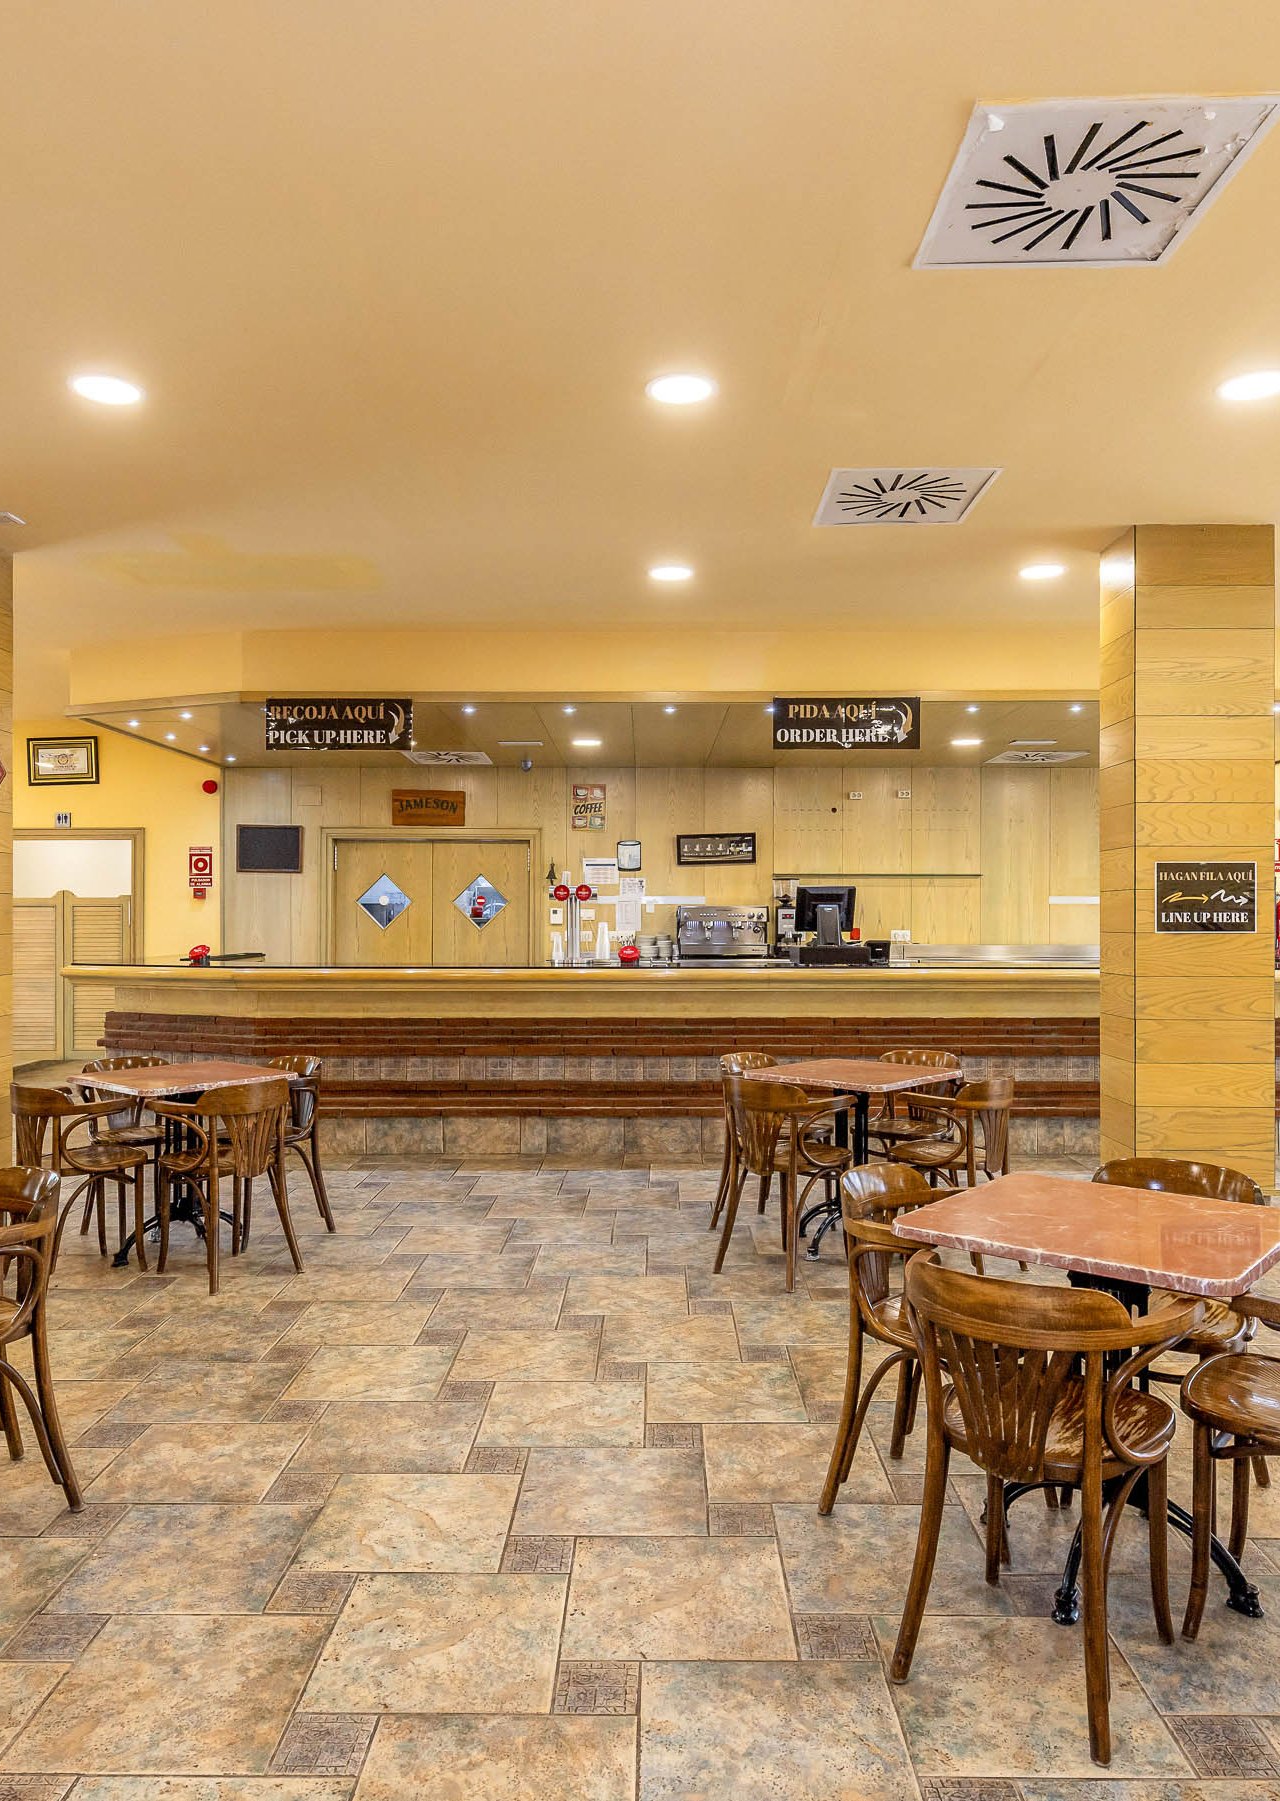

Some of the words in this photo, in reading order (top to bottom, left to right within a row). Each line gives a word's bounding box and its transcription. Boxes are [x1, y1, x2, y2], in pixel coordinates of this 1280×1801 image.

[270, 705, 339, 720] RECOJA
[342, 702, 385, 723] AQUÍ
[788, 704, 830, 719] PIDA
[269, 729, 311, 744] PICK
[313, 729, 336, 744] UP
[339, 729, 386, 744] HERE
[776, 728, 838, 743] ORDER
[398, 797, 458, 814] JAMESON
[574, 802, 603, 815] COFFEE
[1159, 871, 1198, 881] HAGAN
[1200, 871, 1226, 881] FILA
[1226, 869, 1253, 883] AQUÍ
[1161, 912, 1190, 923] LINE
[1194, 912, 1211, 923] UP
[1213, 912, 1248, 923] HERE
